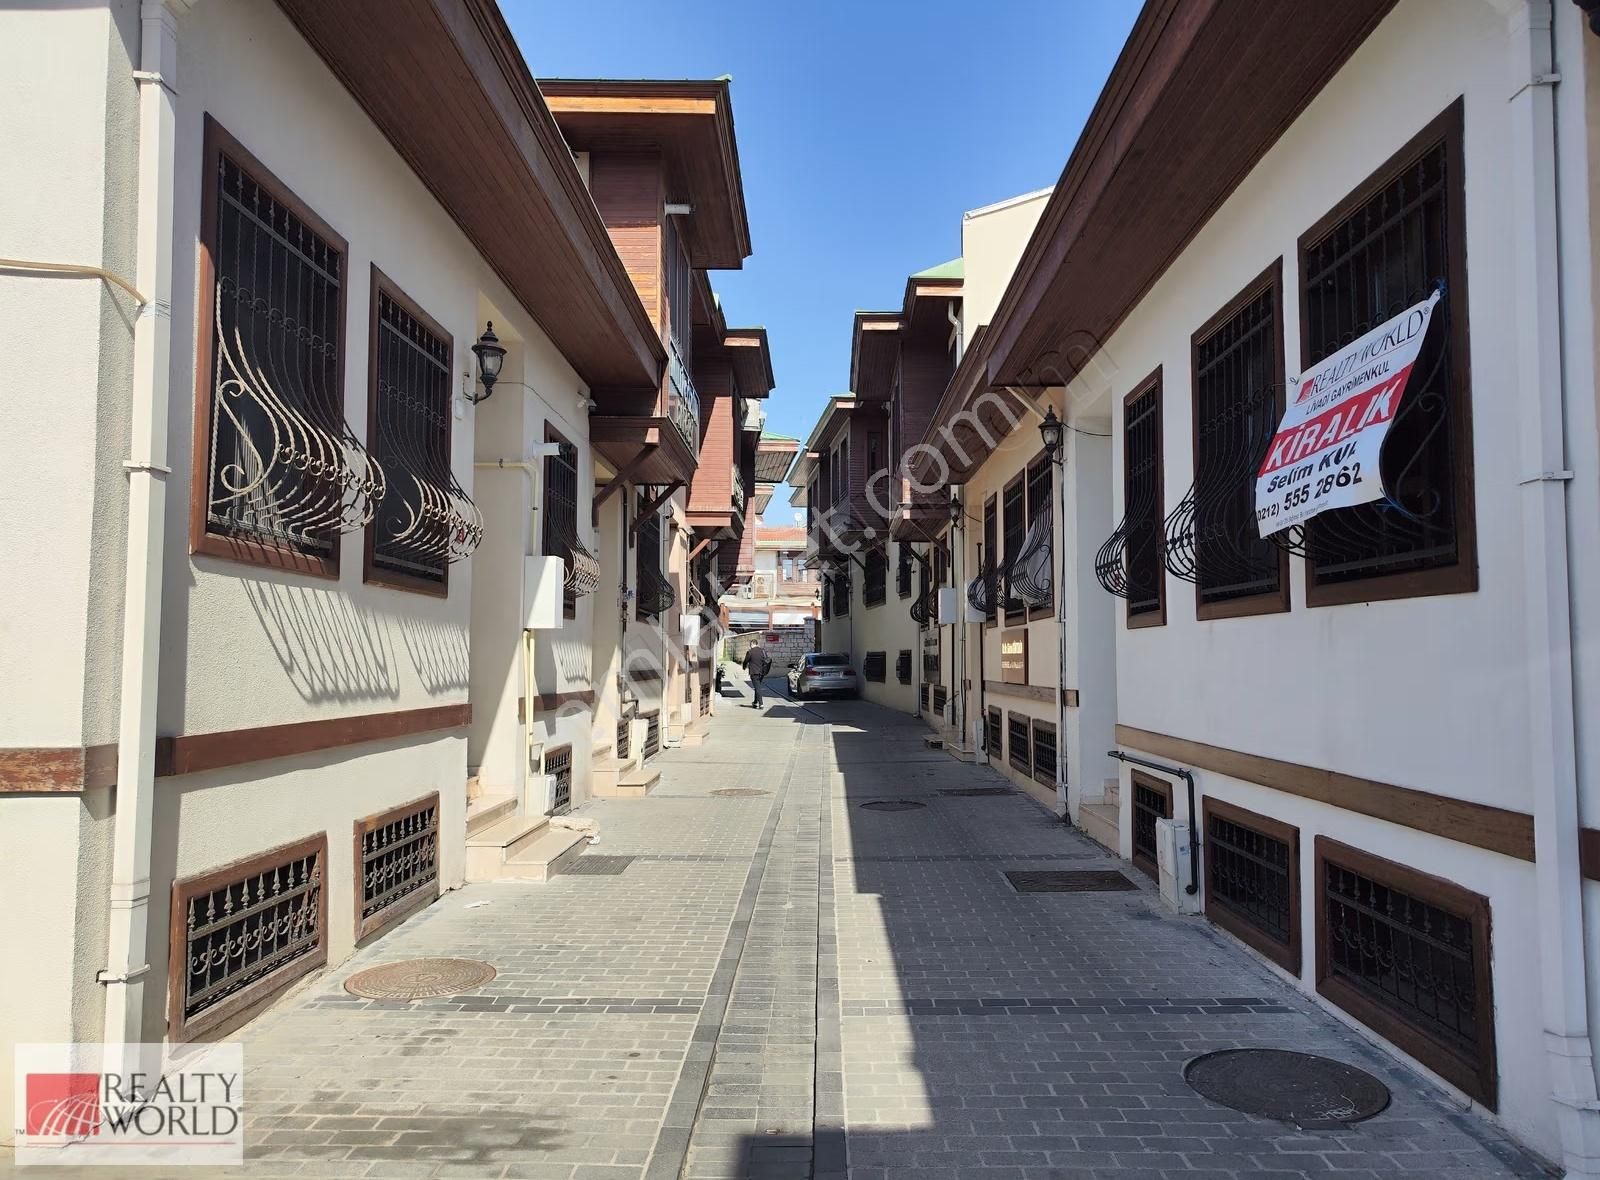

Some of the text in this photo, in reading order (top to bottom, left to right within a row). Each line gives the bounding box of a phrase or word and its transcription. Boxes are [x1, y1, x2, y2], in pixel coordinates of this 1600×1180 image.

[1267, 440, 1358, 494] Selim KUL
[1283, 483, 1311, 511] 555
[1314, 462, 1362, 500] 2862
